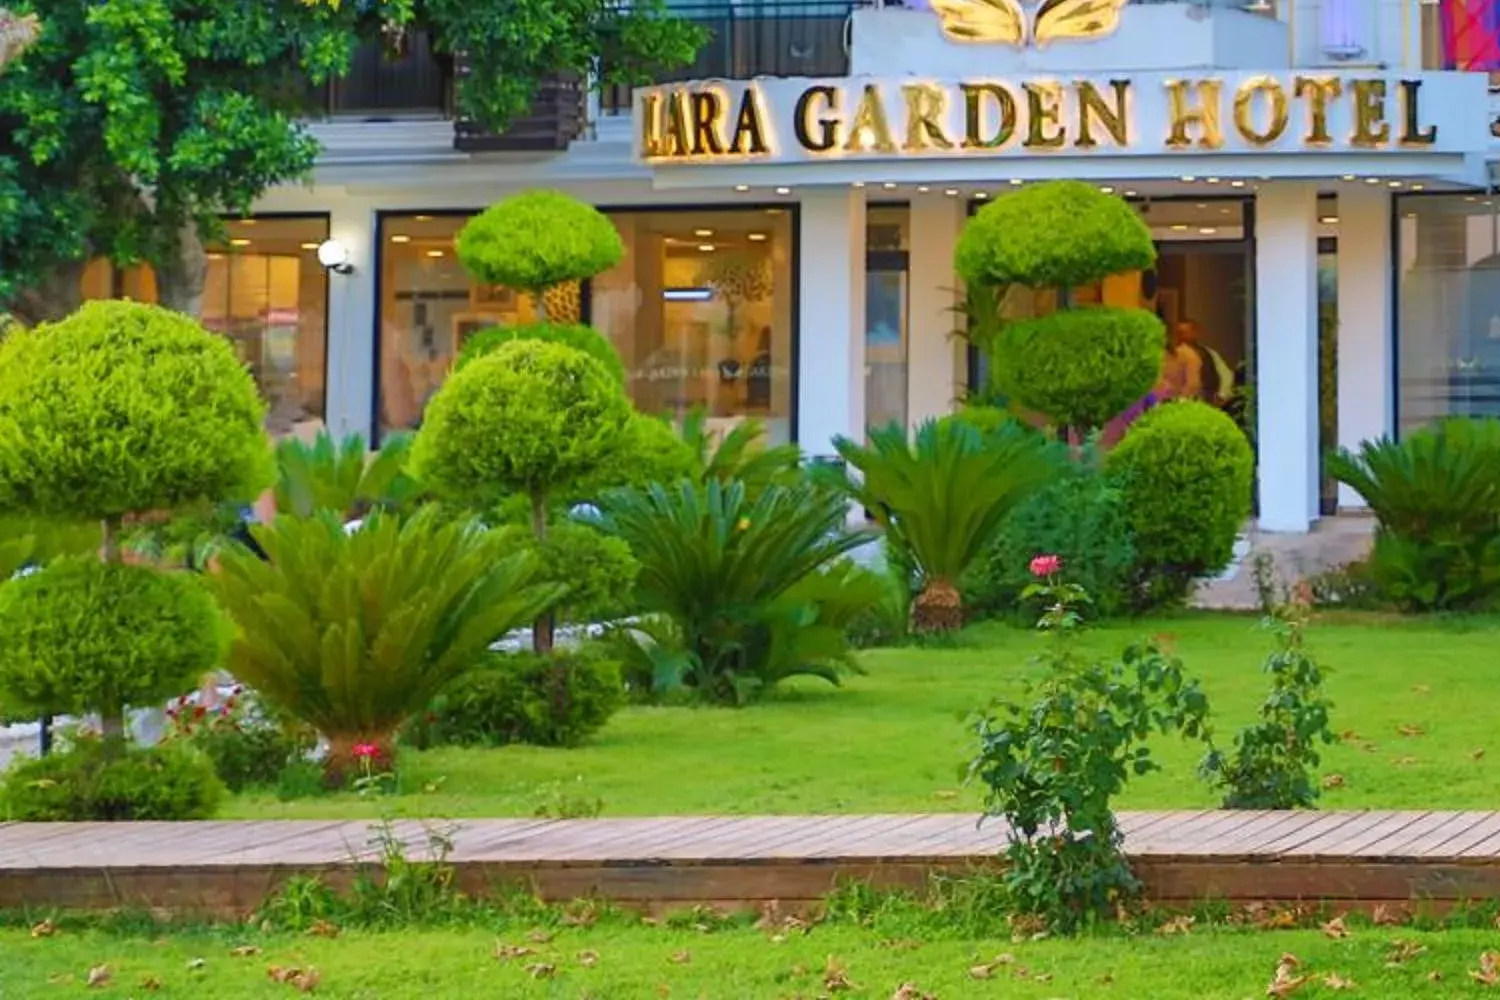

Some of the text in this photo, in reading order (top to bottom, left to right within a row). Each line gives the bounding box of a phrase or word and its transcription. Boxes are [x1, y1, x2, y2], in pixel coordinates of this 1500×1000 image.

[641, 75, 1438, 156] LARA GARDEN HOTEL
